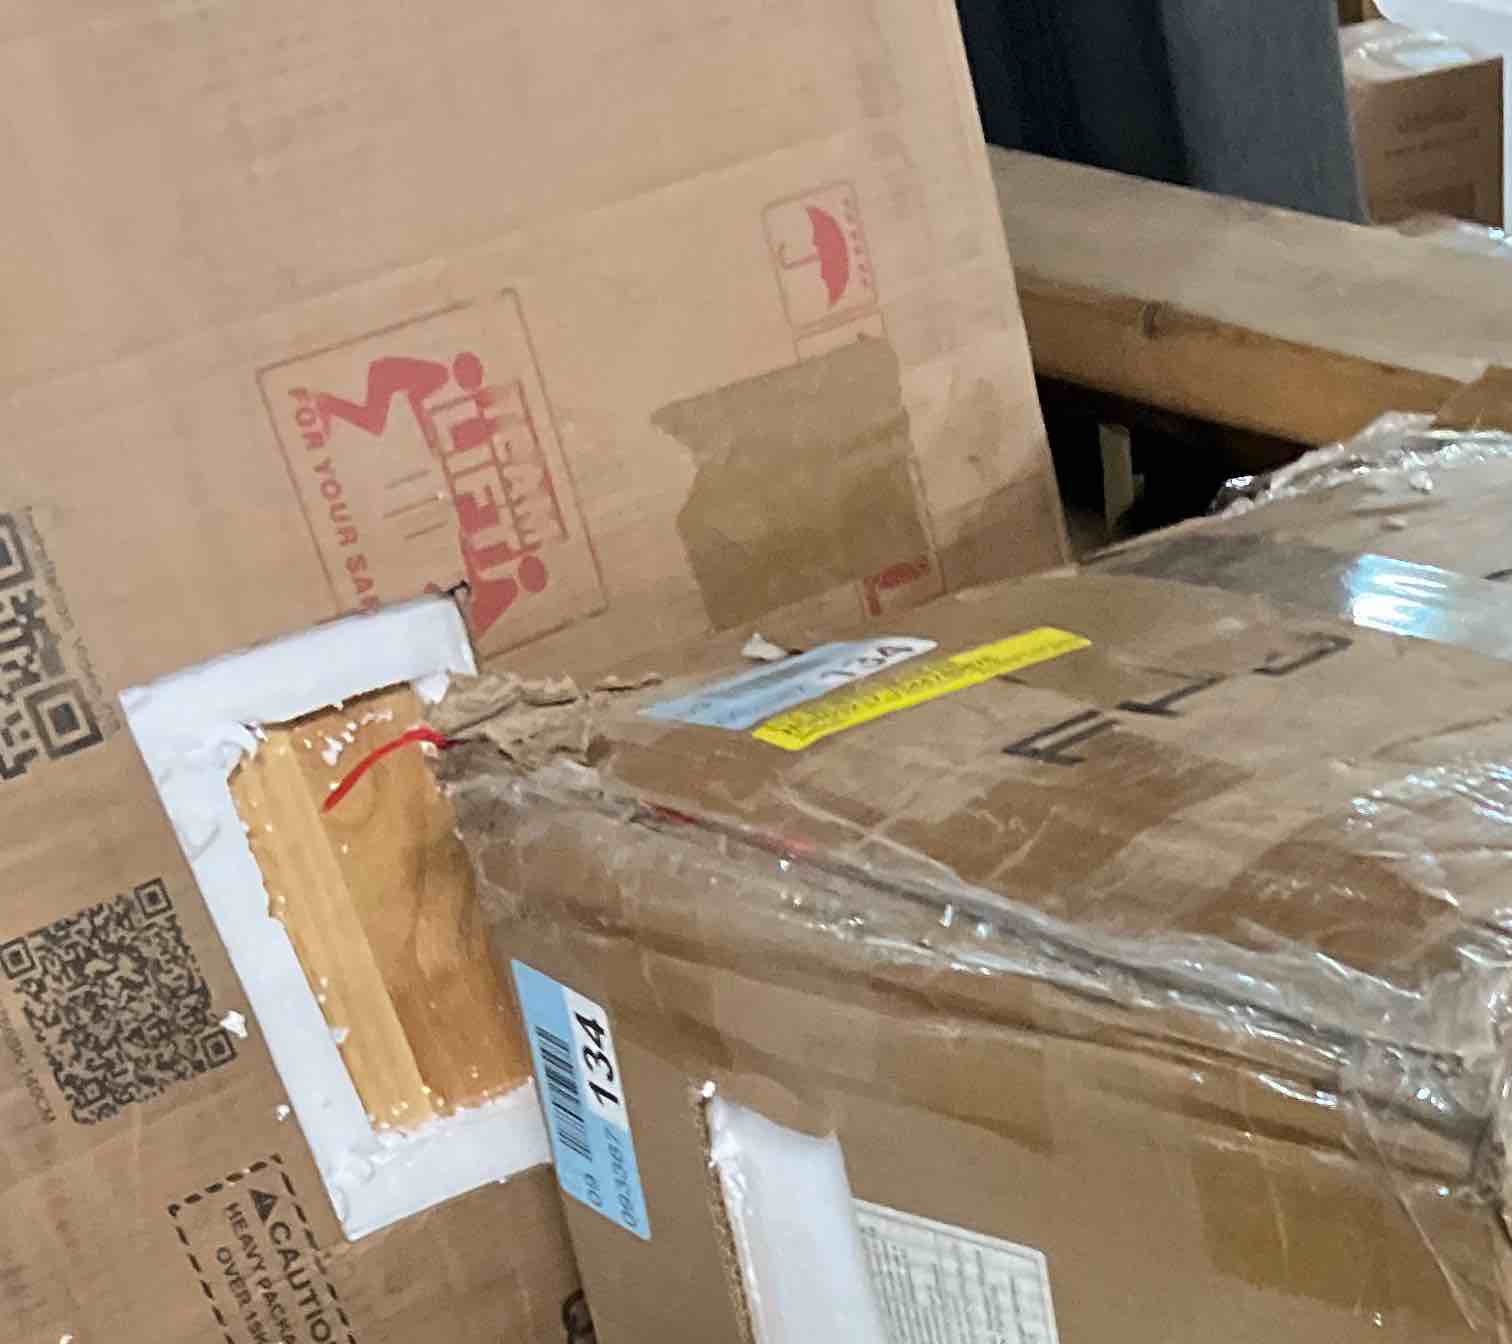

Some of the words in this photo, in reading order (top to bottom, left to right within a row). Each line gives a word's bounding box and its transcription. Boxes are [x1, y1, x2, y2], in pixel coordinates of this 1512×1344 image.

[287, 385, 326, 453] FOR
[314, 456, 359, 547] YOUR
[574, 1009, 620, 1107] 134
[216, 1245, 252, 1310] OVER
[225, 1201, 267, 1274] HEAVY
